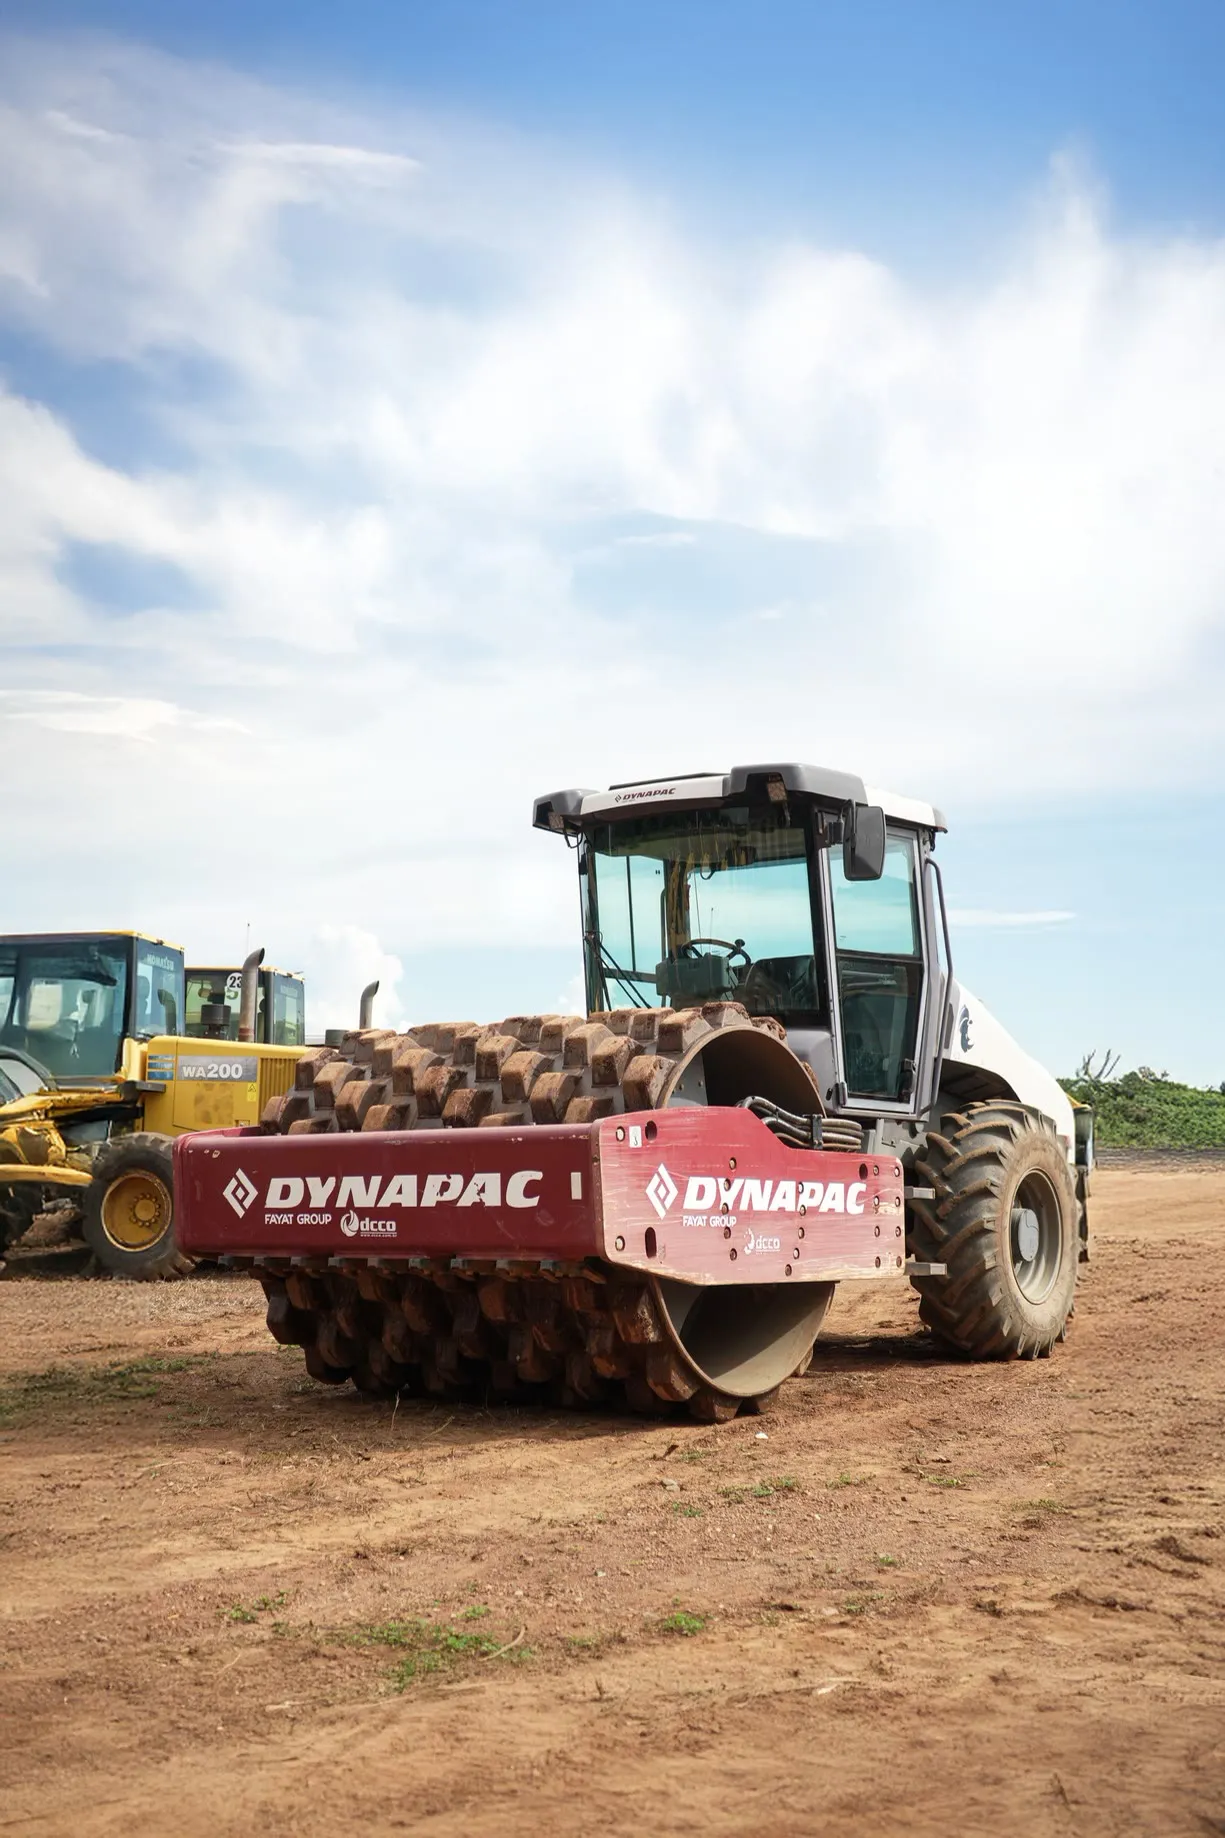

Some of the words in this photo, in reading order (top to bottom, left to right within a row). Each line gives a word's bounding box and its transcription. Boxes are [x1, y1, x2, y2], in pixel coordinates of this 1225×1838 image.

[622, 787, 677, 801] DYNAPAC
[182, 1063, 243, 1079] WA200
[264, 1170, 544, 1209] DYNAPAC
[682, 1176, 867, 1215] DYNAPAC
[264, 1213, 294, 1225] FAYAT
[296, 1213, 332, 1225] GROUP
[360, 1217, 397, 1232] dcco
[682, 1215, 708, 1227] FAYAT
[709, 1215, 737, 1228] GROUP
[755, 1235, 781, 1249] dcco
